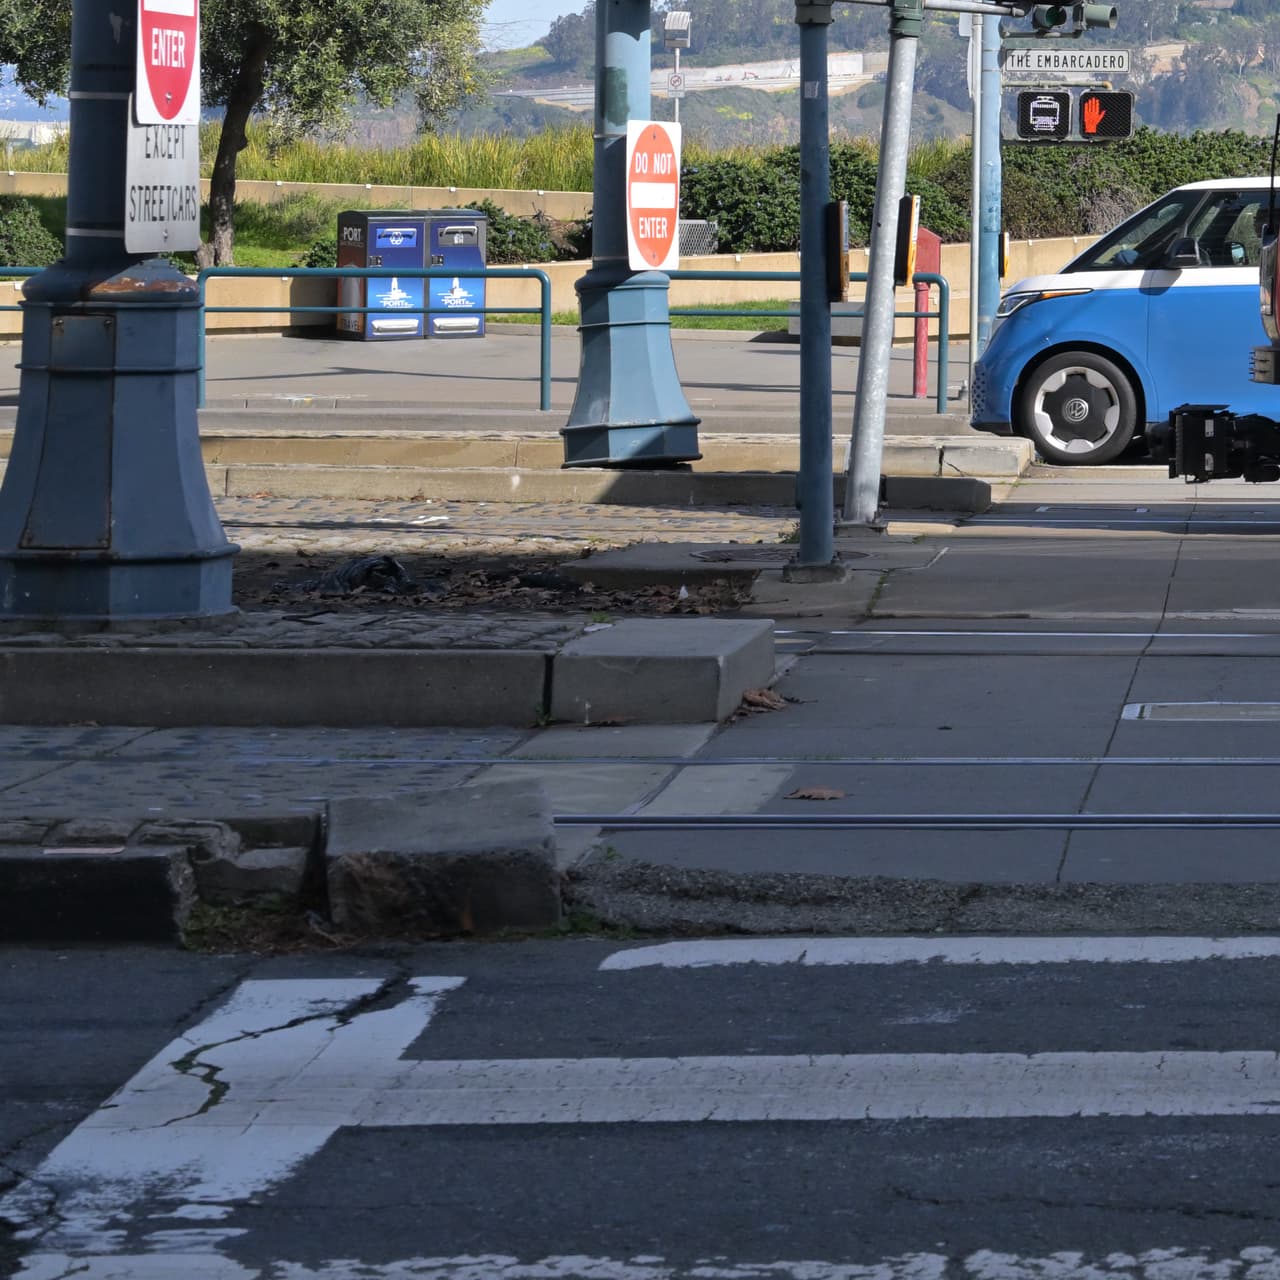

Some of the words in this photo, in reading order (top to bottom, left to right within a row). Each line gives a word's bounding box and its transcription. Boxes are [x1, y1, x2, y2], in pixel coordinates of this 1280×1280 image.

[151, 27, 186, 69] ENTER
[1010, 54, 1031, 68] THE
[1037, 55, 1125, 69] EMBARCADERO
[144, 124, 186, 159] EXCEPT
[634, 152, 649, 174] DO
[653, 152, 673, 174] NOT
[129, 185, 197, 222] STREETCARS
[343, 226, 362, 242] PORT
[638, 216, 668, 239] ENTER
